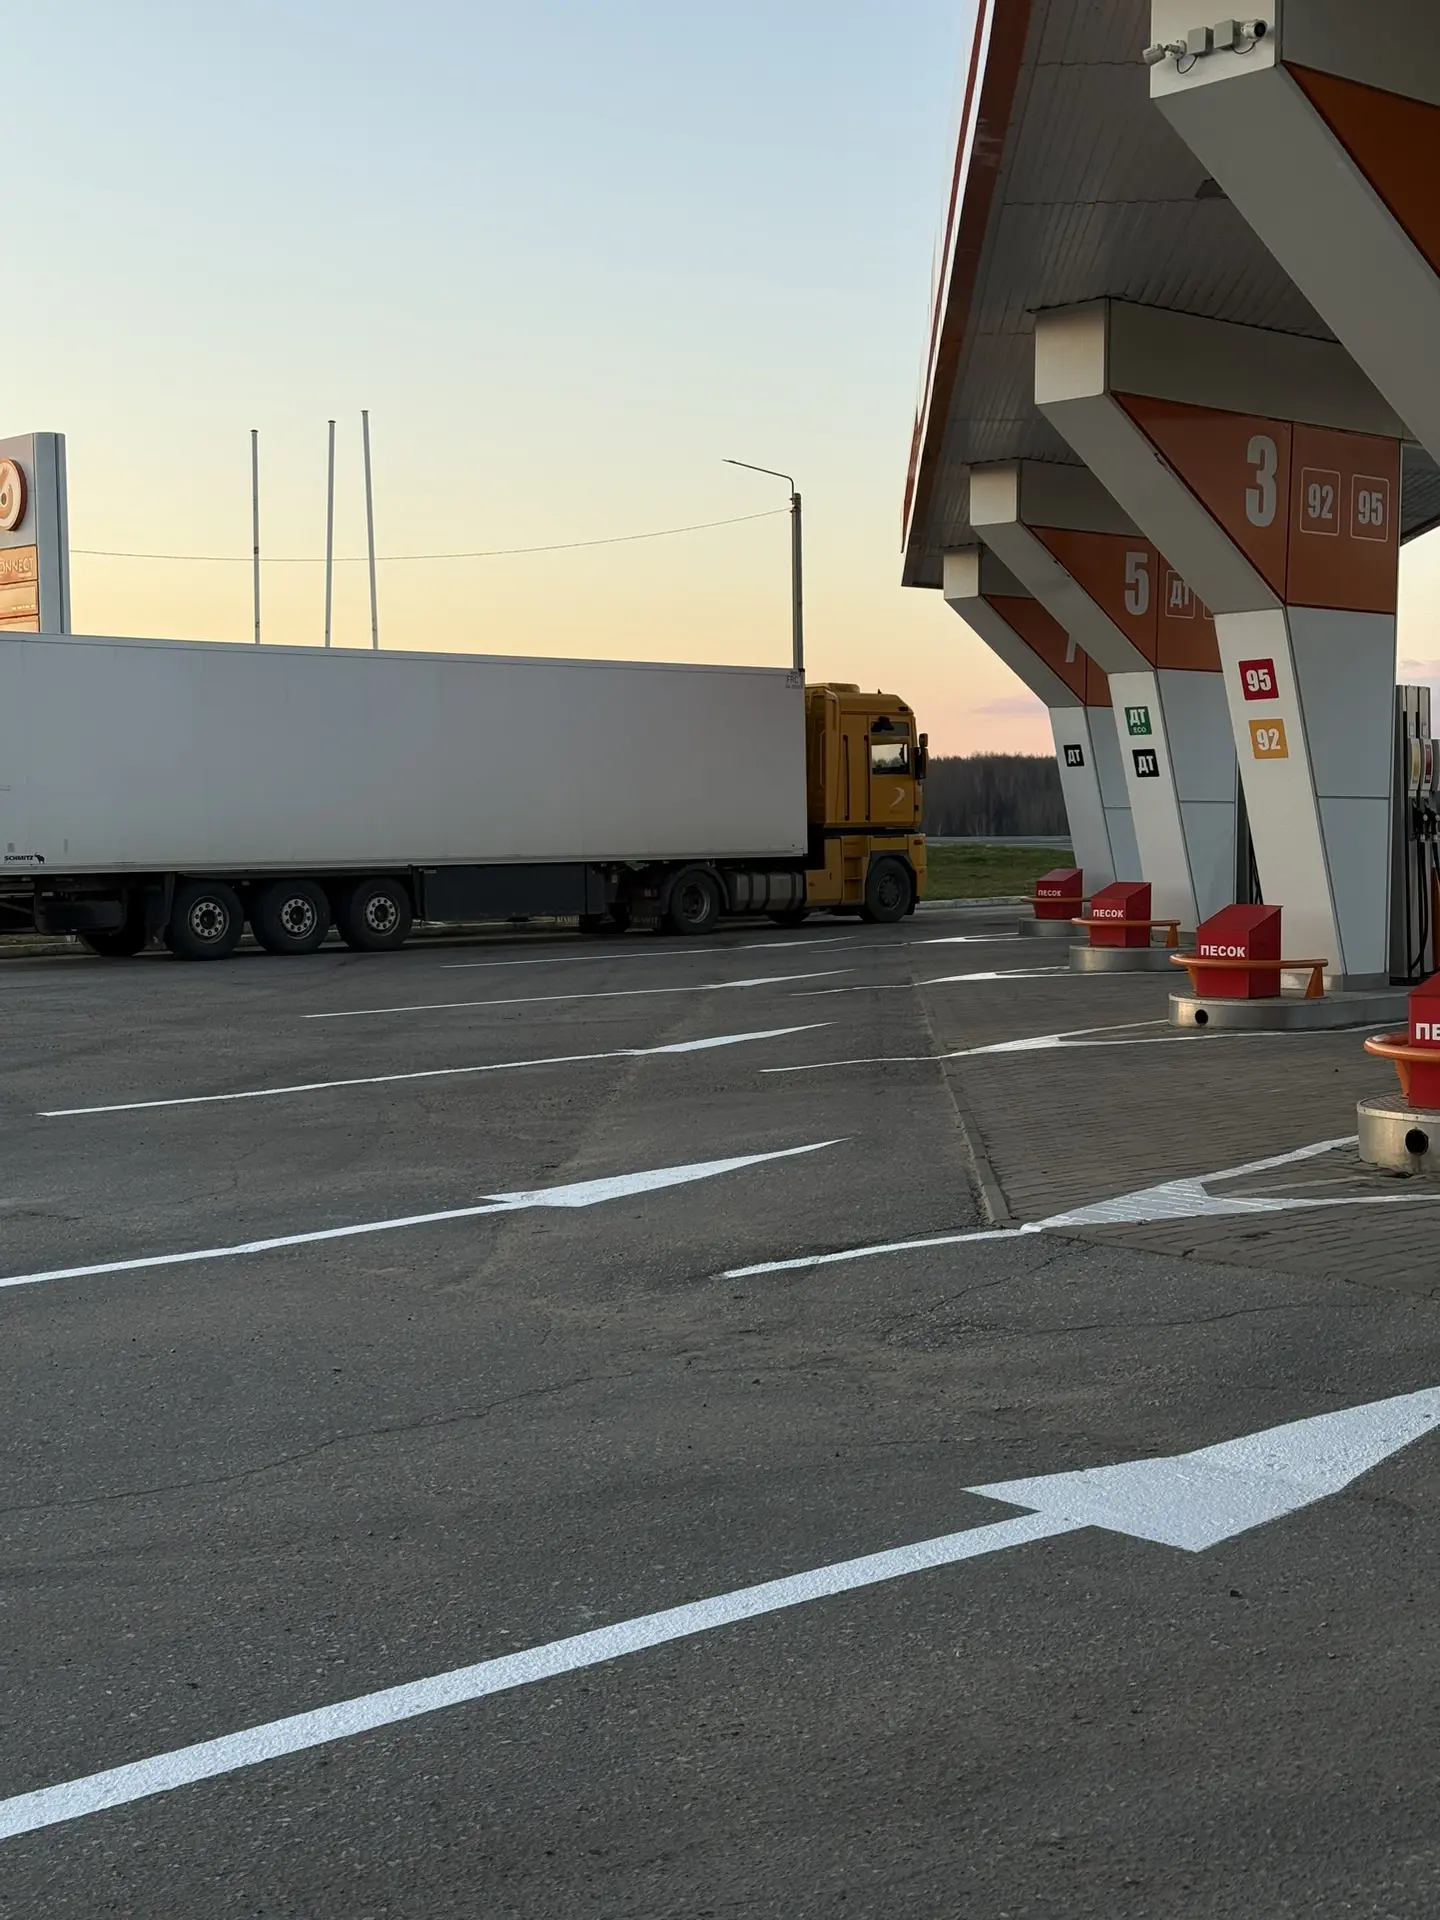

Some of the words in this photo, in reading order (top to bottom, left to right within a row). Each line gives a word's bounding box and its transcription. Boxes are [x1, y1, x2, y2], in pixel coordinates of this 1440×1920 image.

[1245, 434, 1279, 527] 3
[1307, 482, 1334, 520] 92
[1358, 490, 1384, 526] 95
[1124, 552, 1150, 616] 5
[1245, 668, 1272, 693] 95
[1129, 708, 1146, 726] ДТ
[1132, 726, 1147, 734] ECO
[1255, 727, 1281, 752] 92
[1067, 749, 1082, 765] ДТ
[1137, 754, 1156, 774] ДТ
[1037, 889, 1062, 897] ПЕСОК
[1092, 909, 1124, 918] ПЕСОК
[1200, 944, 1246, 958] ПЕСОК
